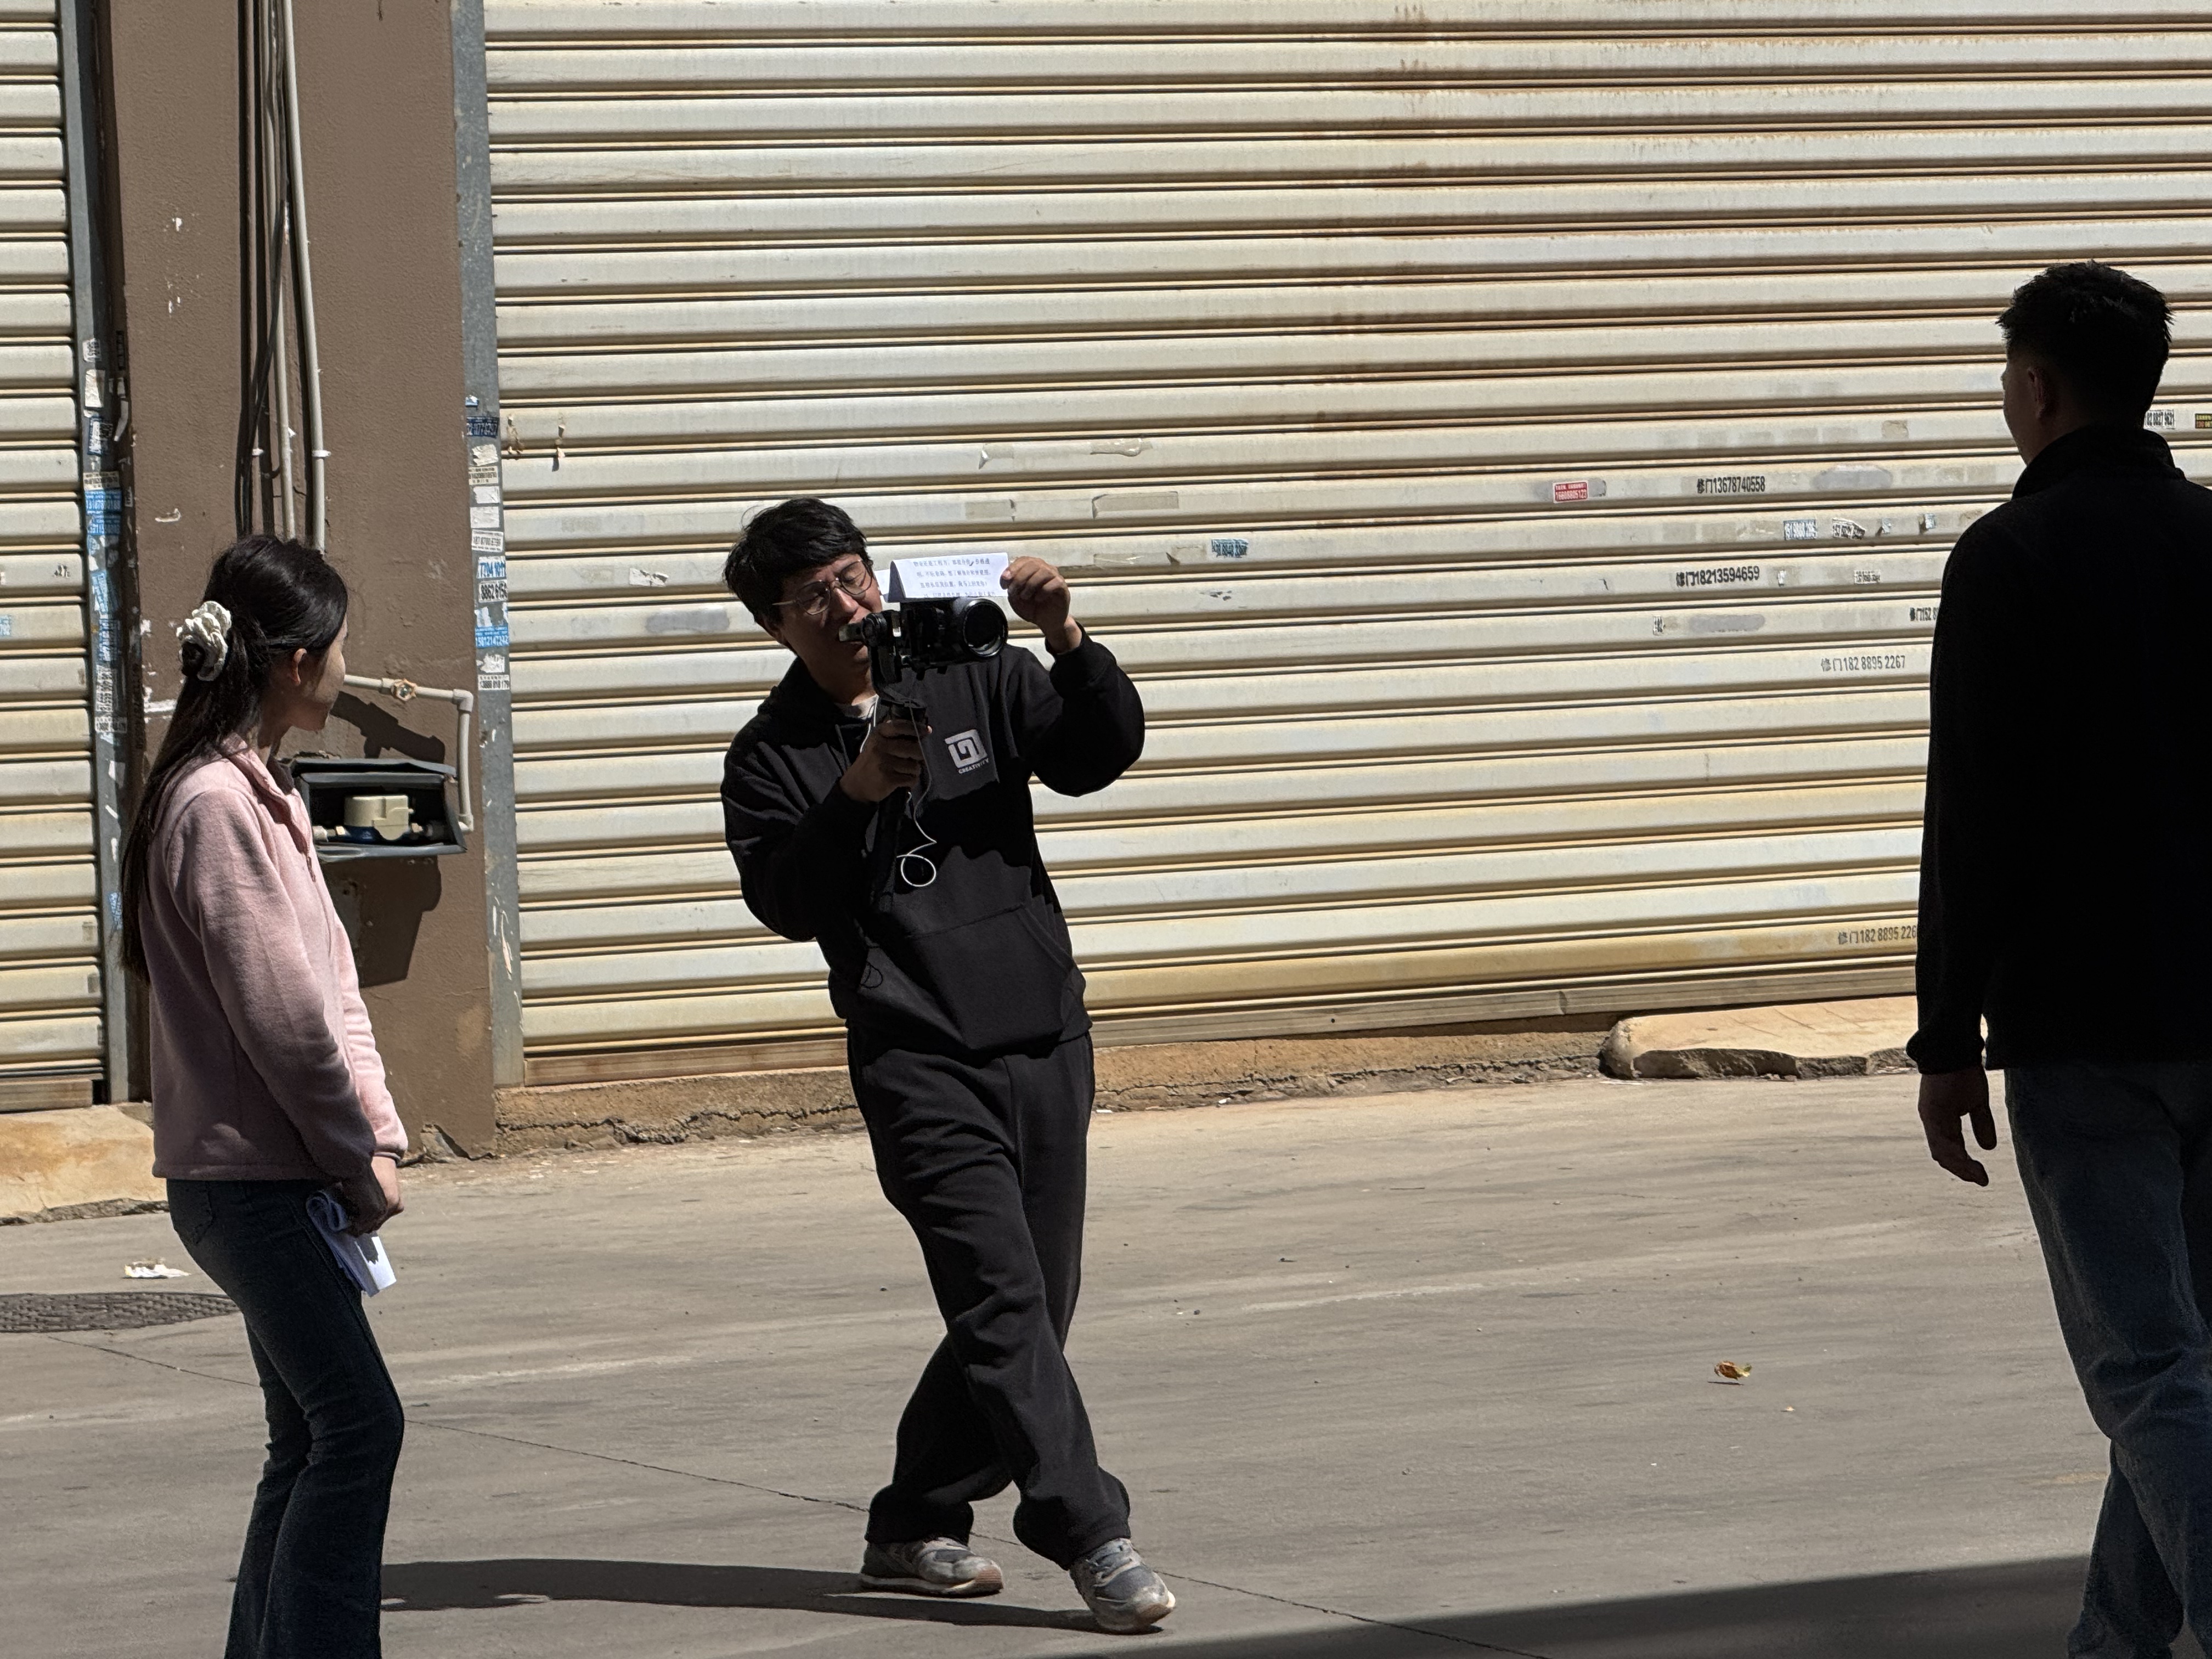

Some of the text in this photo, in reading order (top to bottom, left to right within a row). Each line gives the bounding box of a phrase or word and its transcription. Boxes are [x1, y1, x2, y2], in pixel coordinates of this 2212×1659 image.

[1861, 656, 1883, 670] 8895
[1884, 654, 1905, 669] 2267
[958, 758, 989, 774] CREATIVITY
[1878, 927, 1899, 941] 8895
[1901, 925, 1917, 939] 226
